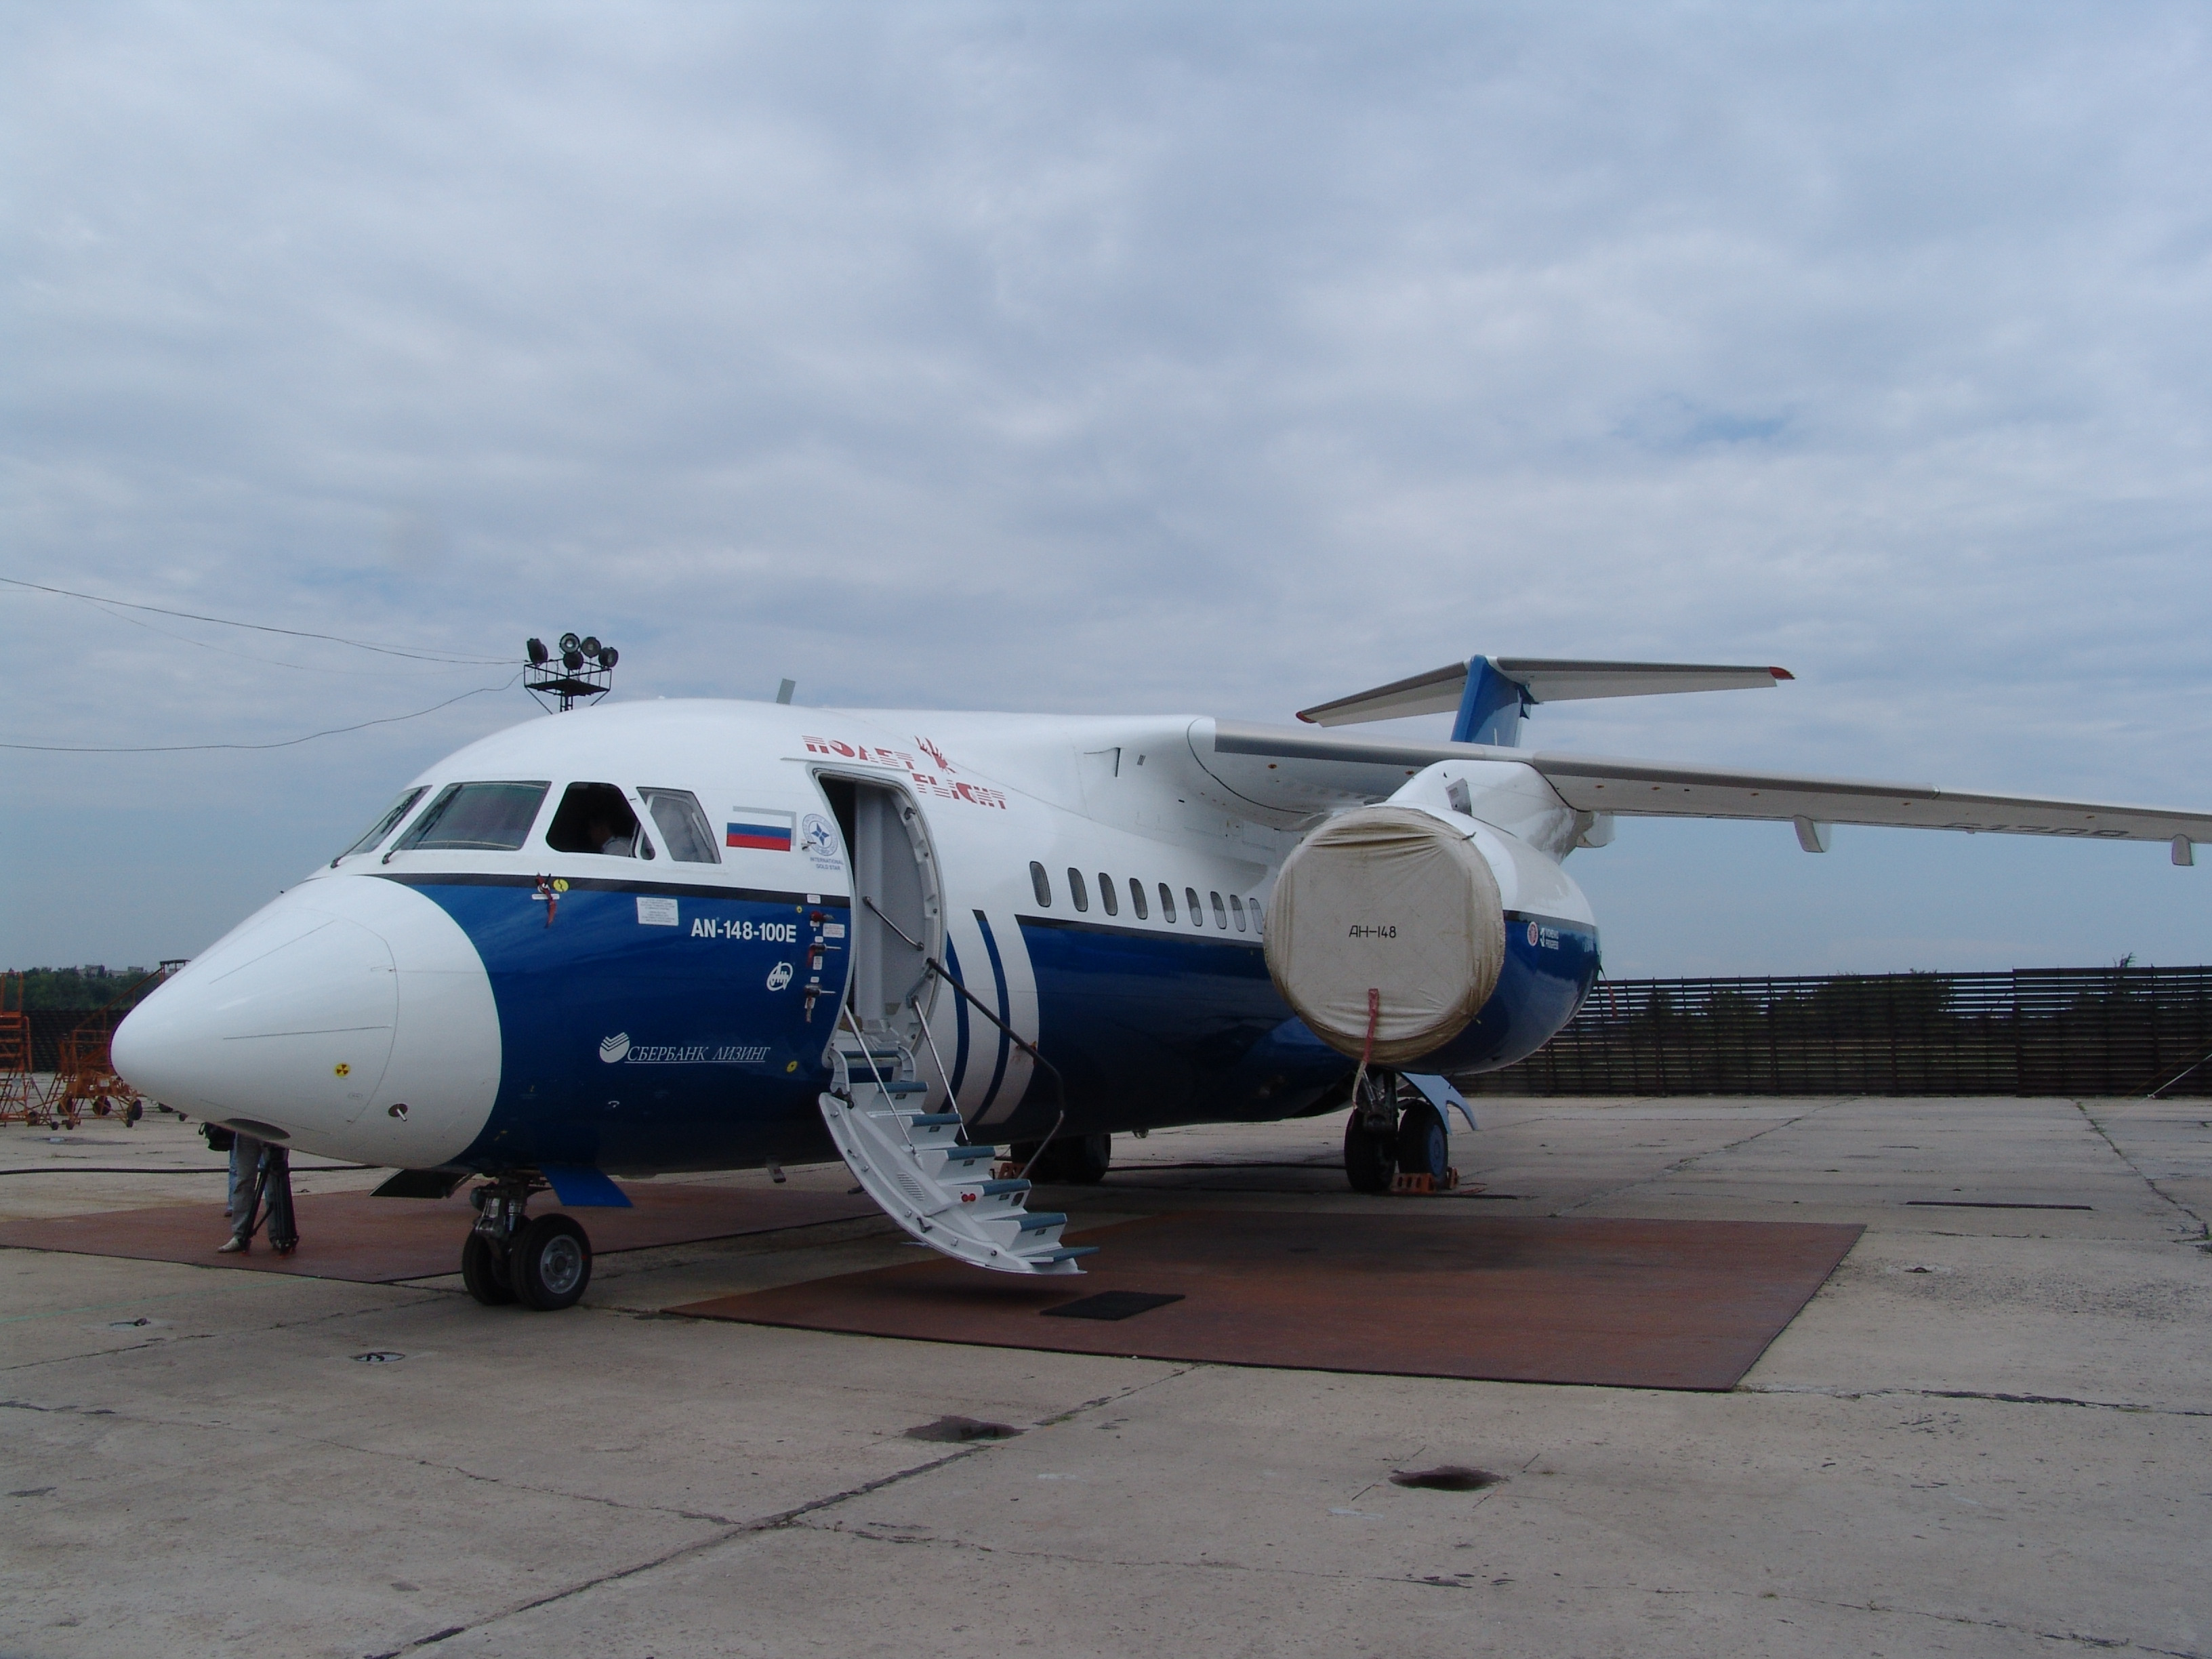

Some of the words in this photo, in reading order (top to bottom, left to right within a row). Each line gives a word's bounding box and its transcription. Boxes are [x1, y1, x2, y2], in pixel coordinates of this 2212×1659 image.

[912, 773, 1006, 810] FLIGHT
[810, 857, 844, 865] INTERNATIONAL
[691, 918, 797, 943] AN-148-100E
[627, 1046, 709, 1061] СБЕРБАНК
[712, 1046, 771, 1061] ЛИЗИНГ
